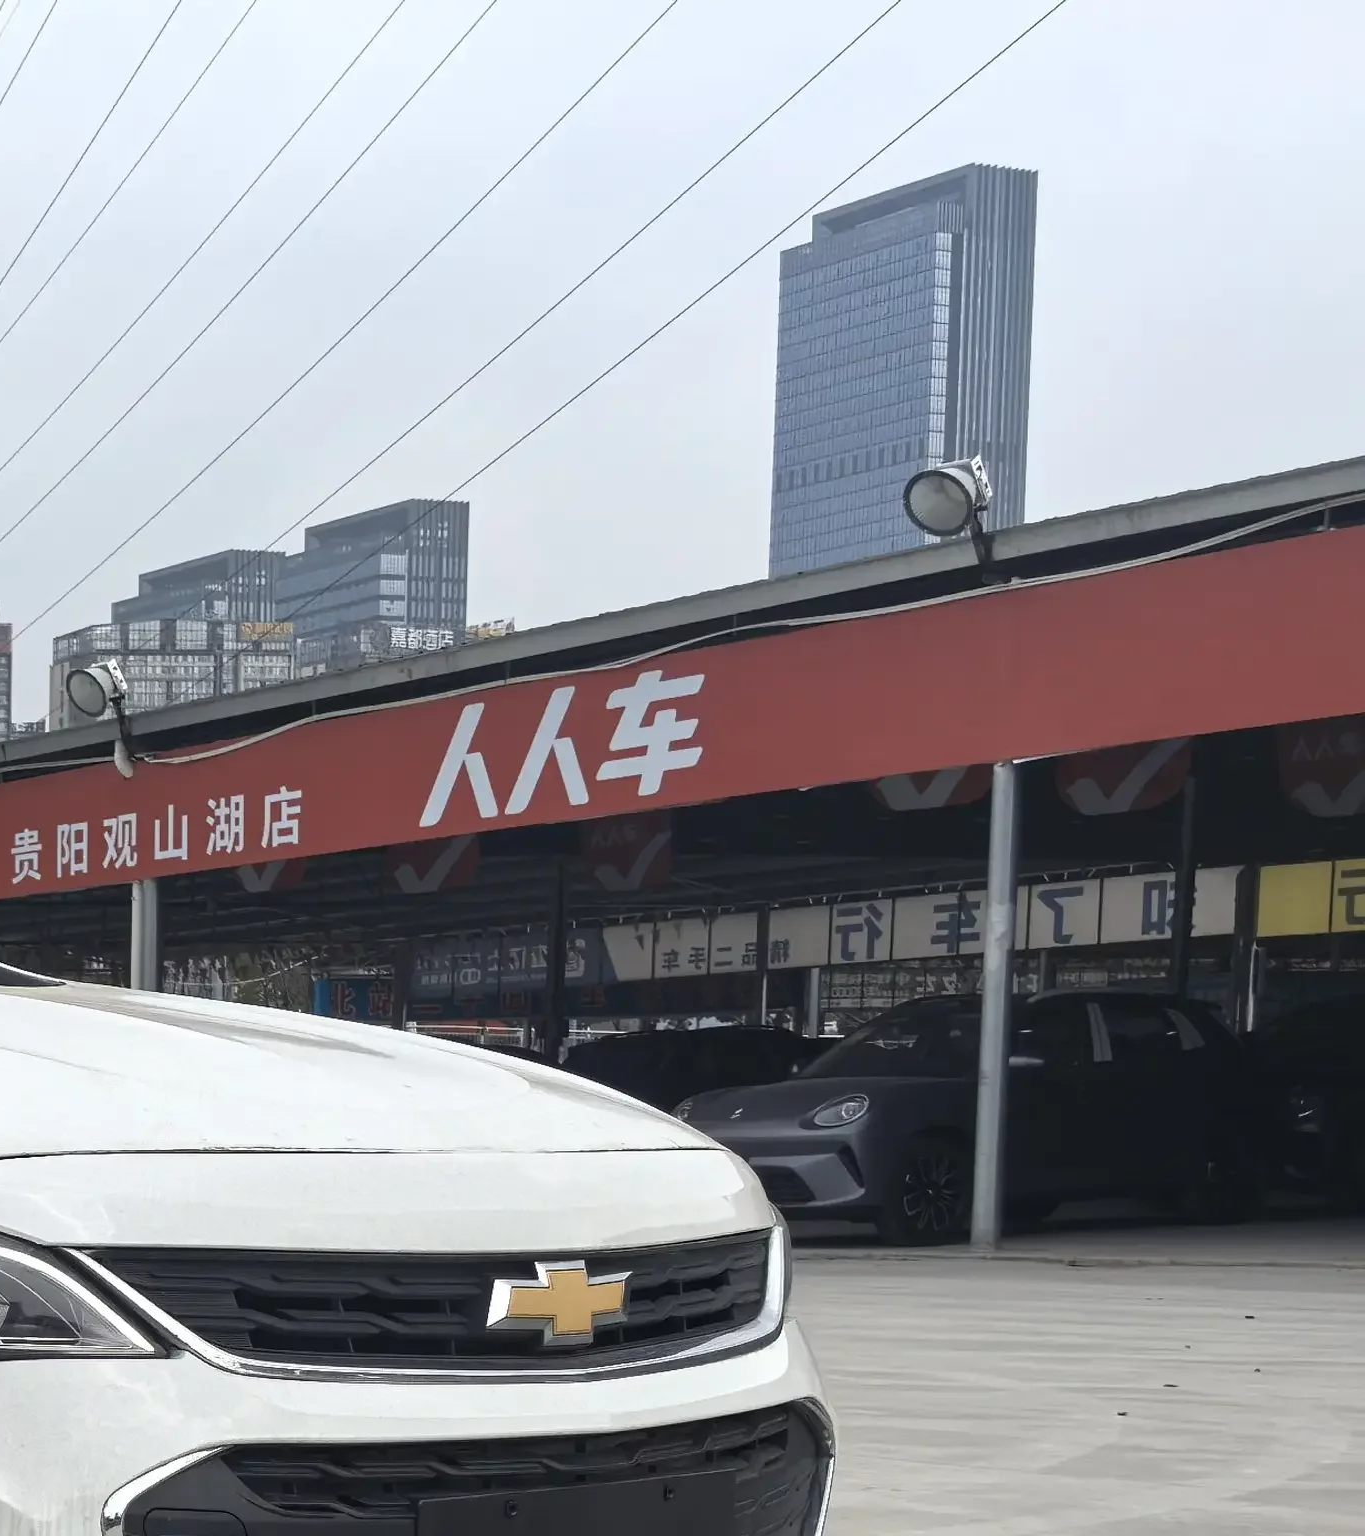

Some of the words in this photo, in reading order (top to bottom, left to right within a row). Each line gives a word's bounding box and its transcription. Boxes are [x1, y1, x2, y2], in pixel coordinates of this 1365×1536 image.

[390, 627, 453, 650] 嘉都酒店
[419, 670, 705, 827] 人人车
[11, 785, 303, 885] 贵阳观山湖店
